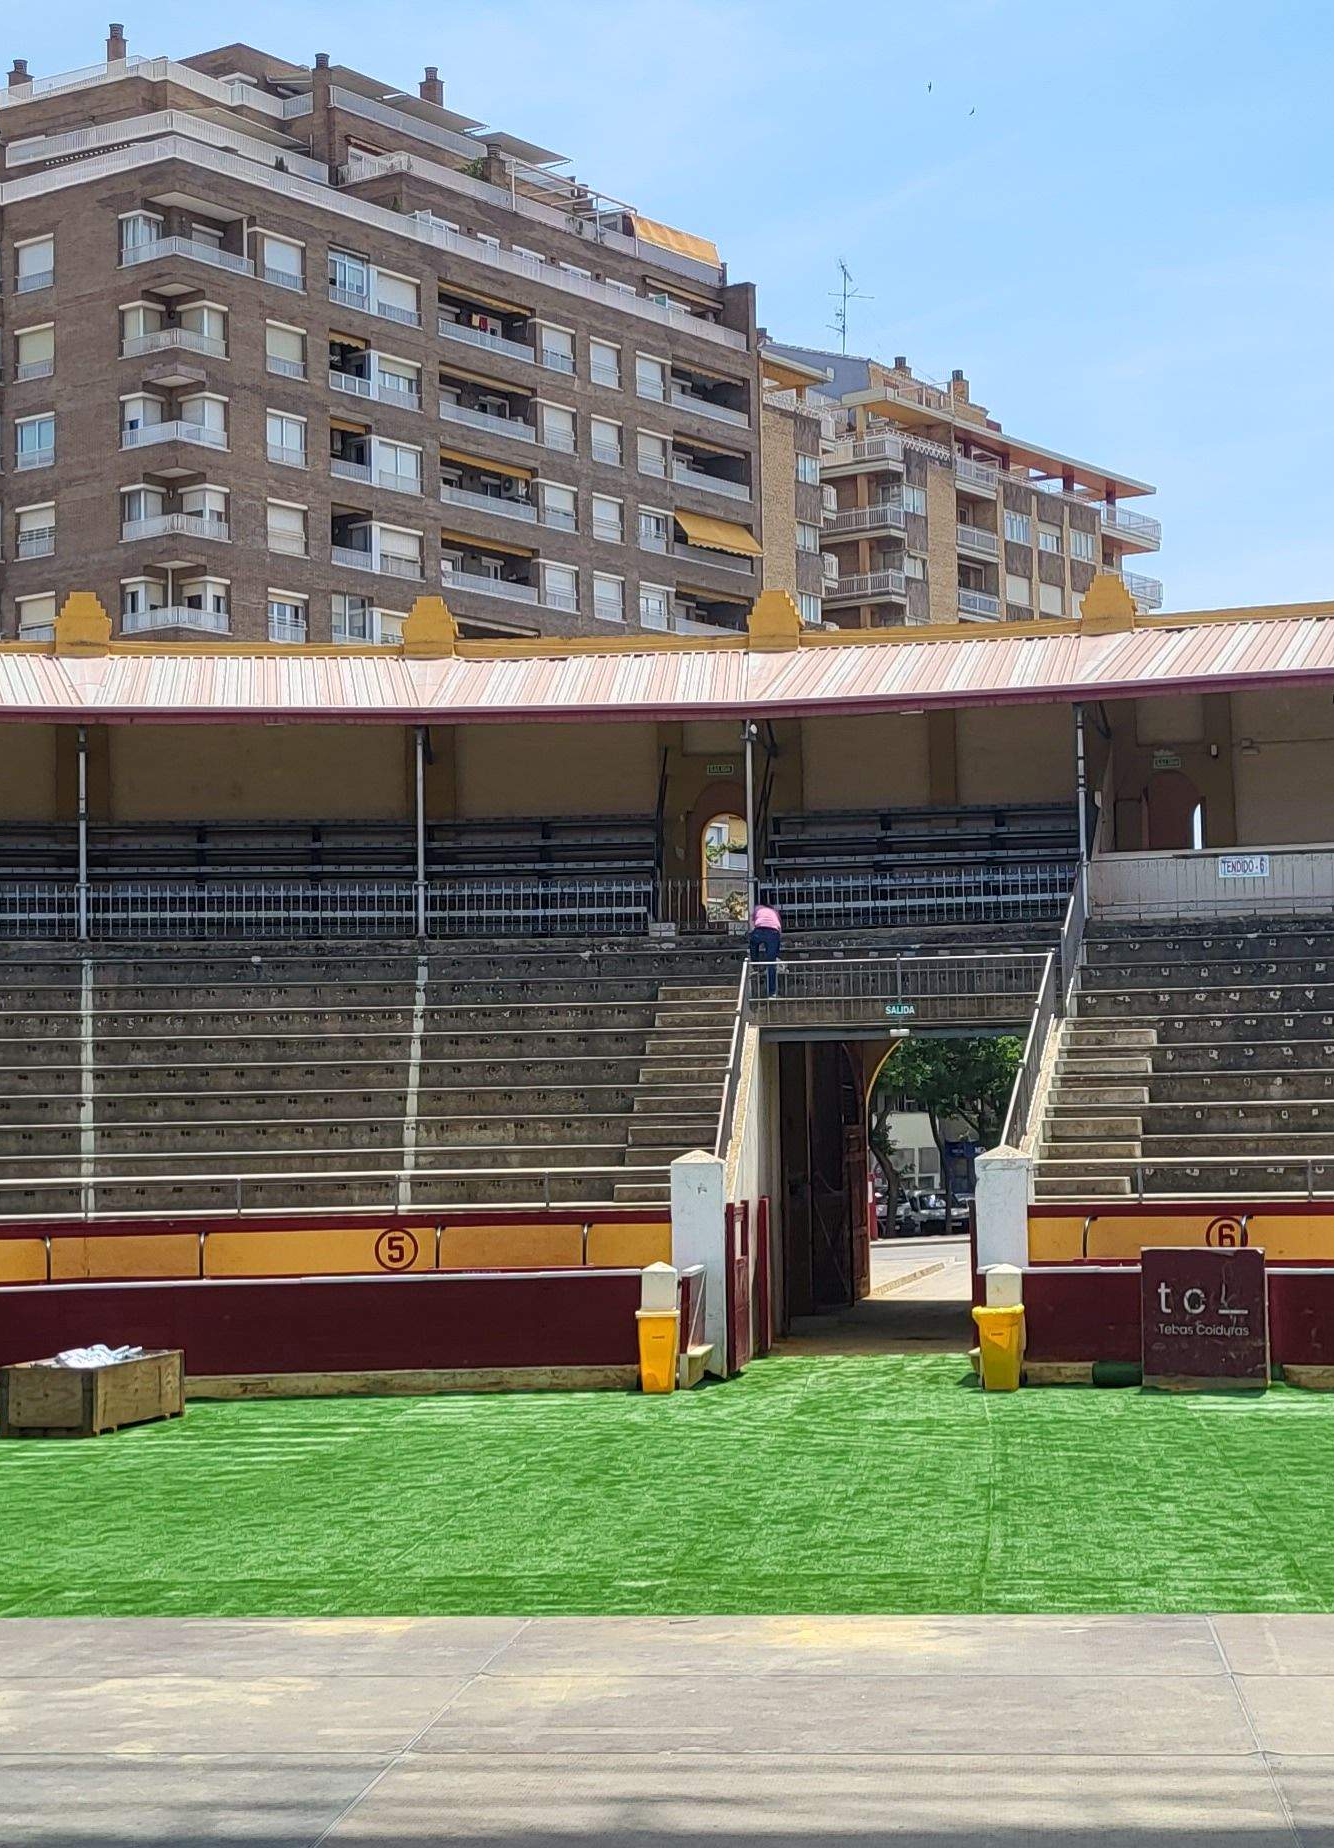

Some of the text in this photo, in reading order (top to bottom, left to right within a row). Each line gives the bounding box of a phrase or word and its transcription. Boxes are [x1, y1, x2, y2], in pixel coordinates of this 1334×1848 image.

[885, 1005, 915, 1015] SALIDA
[1218, 1223, 1236, 1247] 6
[387, 1235, 405, 1263] 5
